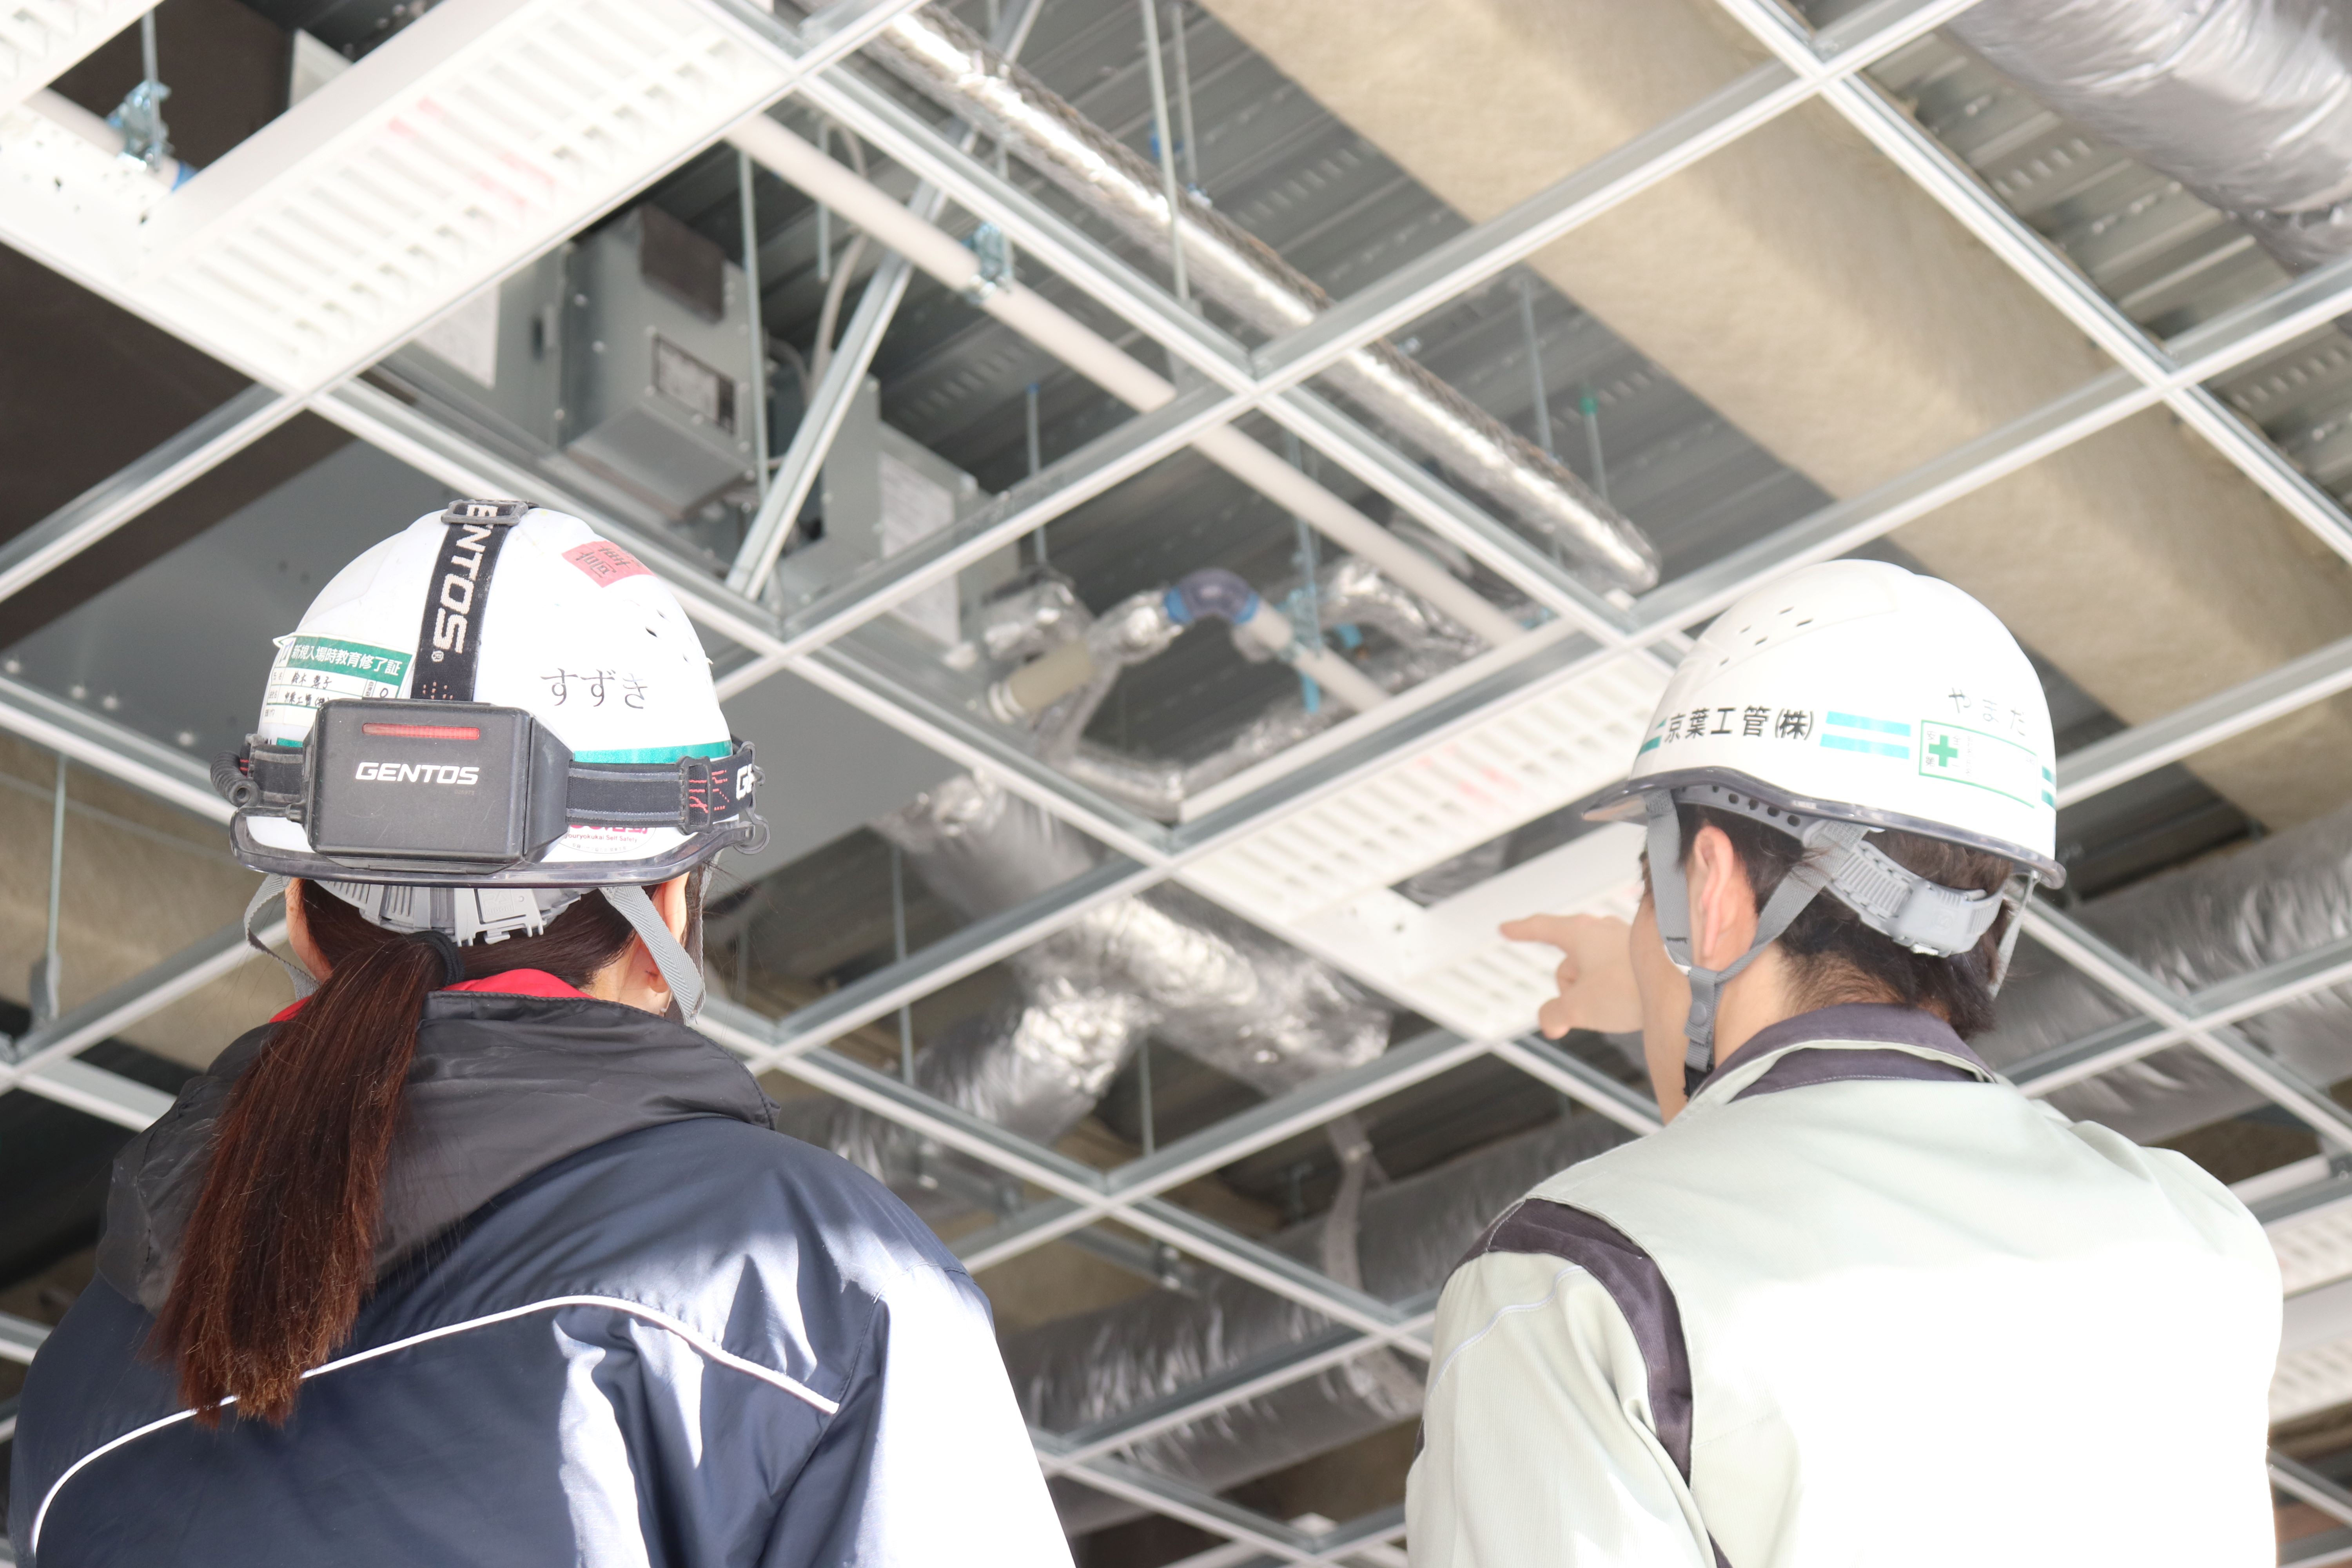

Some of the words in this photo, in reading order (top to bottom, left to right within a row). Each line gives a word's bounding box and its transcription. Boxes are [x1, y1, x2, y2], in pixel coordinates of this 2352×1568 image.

[291, 644, 403, 676] 新規入場時教育修了証
[540, 668, 648, 709] すずき
[1948, 687, 2026, 737] やまだ
[355, 762, 480, 785] GENTOS
[619, 835, 637, 843] Safety
